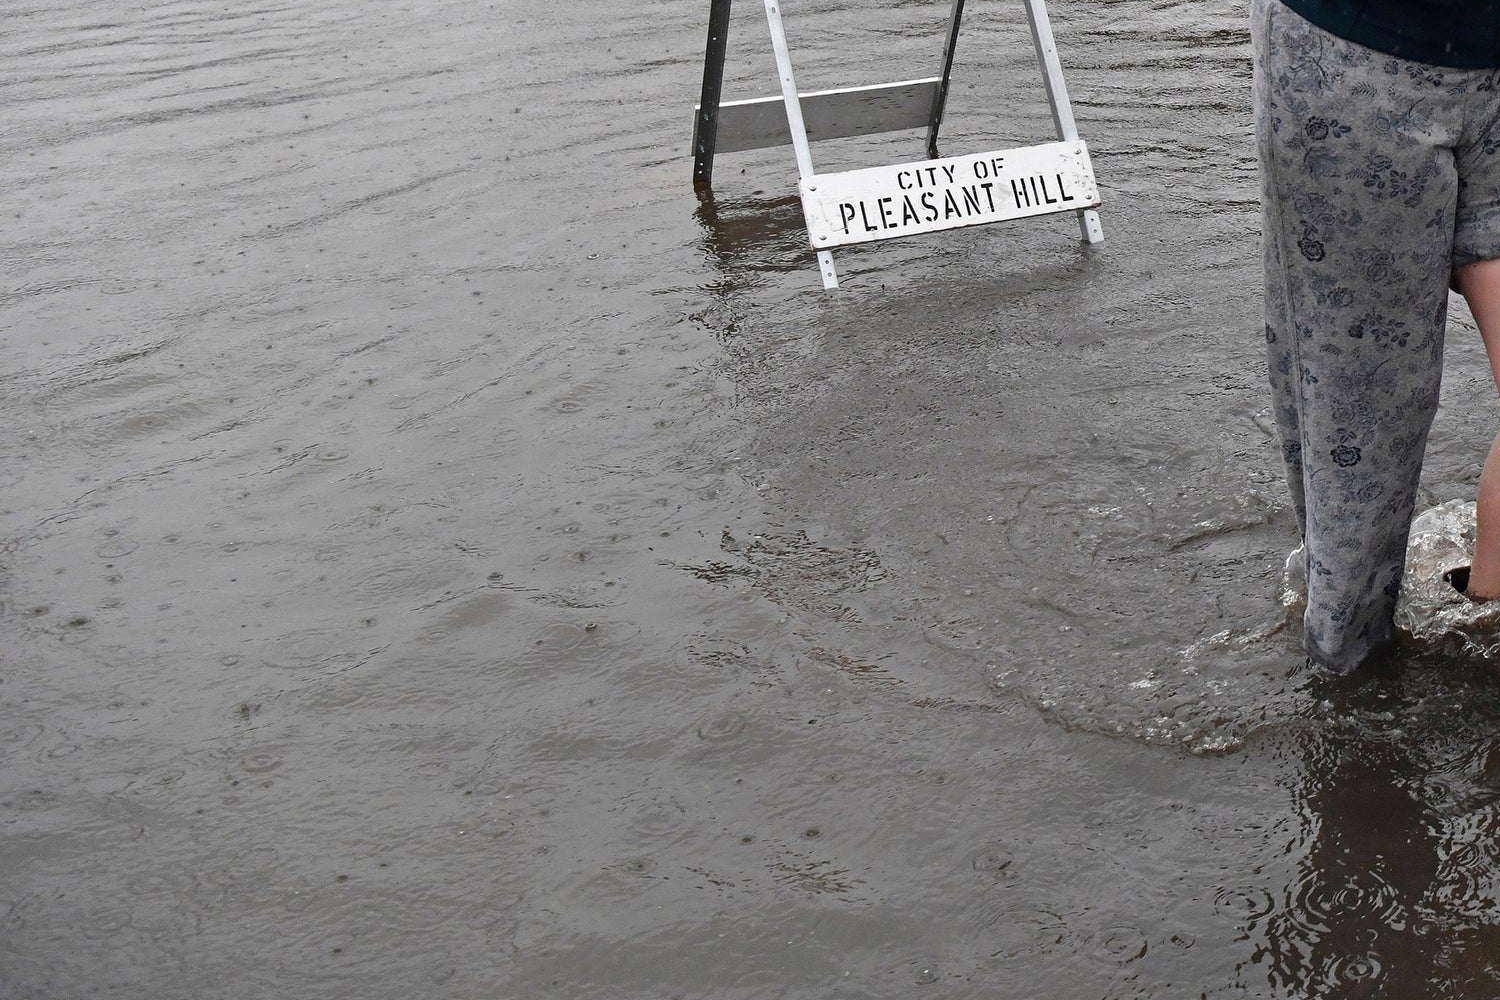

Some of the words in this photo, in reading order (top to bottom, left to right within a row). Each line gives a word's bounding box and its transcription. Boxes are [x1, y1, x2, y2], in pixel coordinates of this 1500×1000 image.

[897, 164, 956, 190] CITY
[973, 157, 1005, 180] OF
[838, 182, 996, 235] PLEASANT
[1010, 173, 1075, 209] HILL
